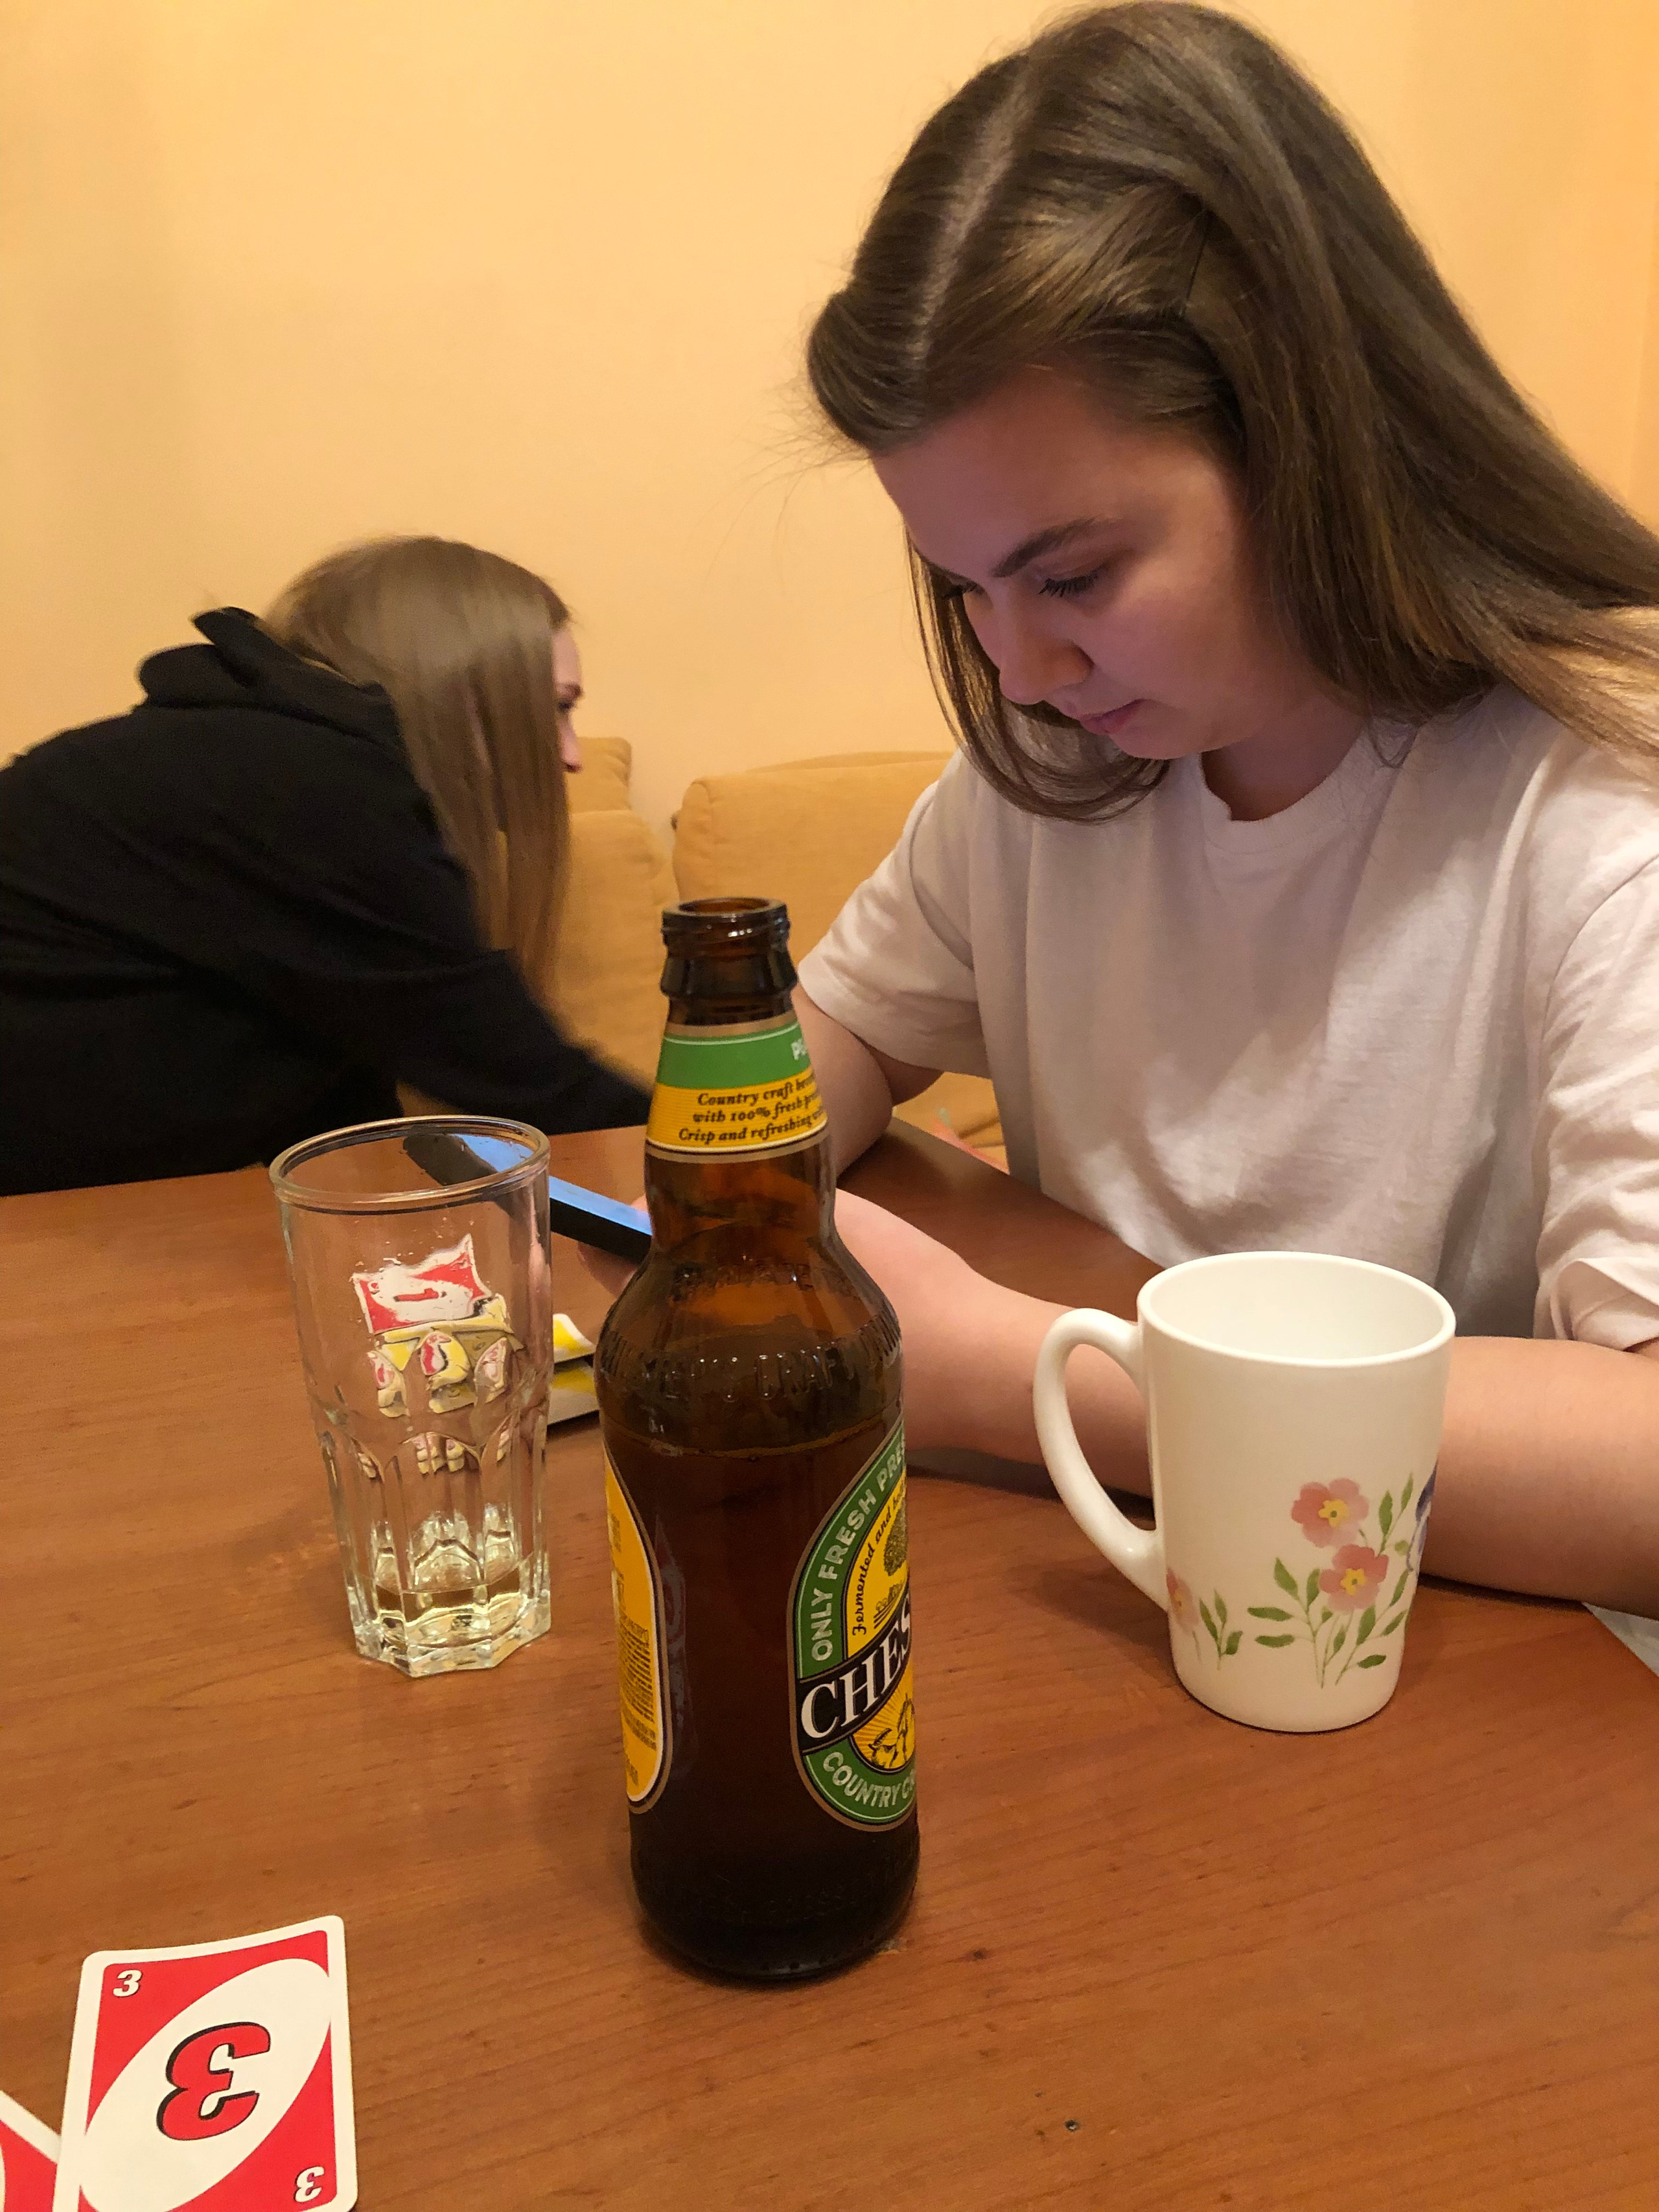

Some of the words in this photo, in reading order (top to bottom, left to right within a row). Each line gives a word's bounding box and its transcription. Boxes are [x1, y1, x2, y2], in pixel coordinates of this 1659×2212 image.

[693, 1109, 726, 1123] with
[730, 1107, 771, 1121] 100%
[772, 1097, 804, 1120] fresh
[697, 1092, 759, 1106] Country
[763, 1082, 793, 1100] craft
[679, 1127, 715, 1145] Crisp
[719, 1128, 748, 1141] and
[751, 1115, 813, 1141] refreshing
[818, 1488, 877, 1581] FRESH
[852, 1542, 875, 1636] Fermented
[875, 1504, 891, 1544] and
[810, 1588, 833, 1662] ONLY
[822, 1751, 902, 1808] COUNTRY
[112, 1969, 143, 1997] 3
[156, 2021, 271, 2141] 3
[294, 2166, 325, 2204] 3
